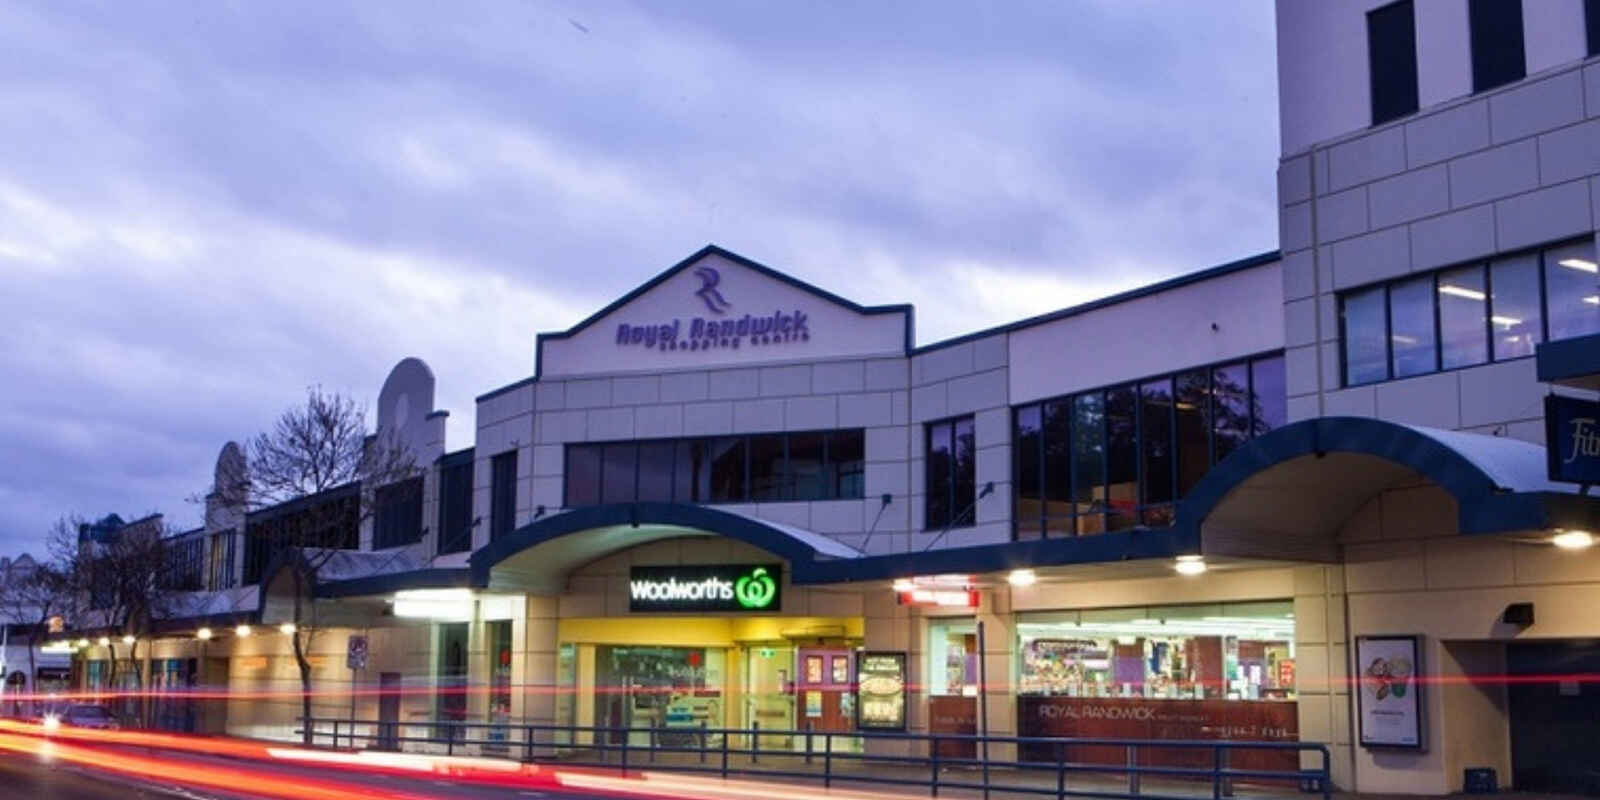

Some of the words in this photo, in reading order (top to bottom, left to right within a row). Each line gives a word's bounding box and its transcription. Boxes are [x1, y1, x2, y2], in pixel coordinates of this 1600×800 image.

[616, 319, 680, 348] Royal
[690, 310, 809, 339] Randwick
[1039, 704, 1079, 719] ROYAL
[1081, 704, 1156, 721] RANDWICK
